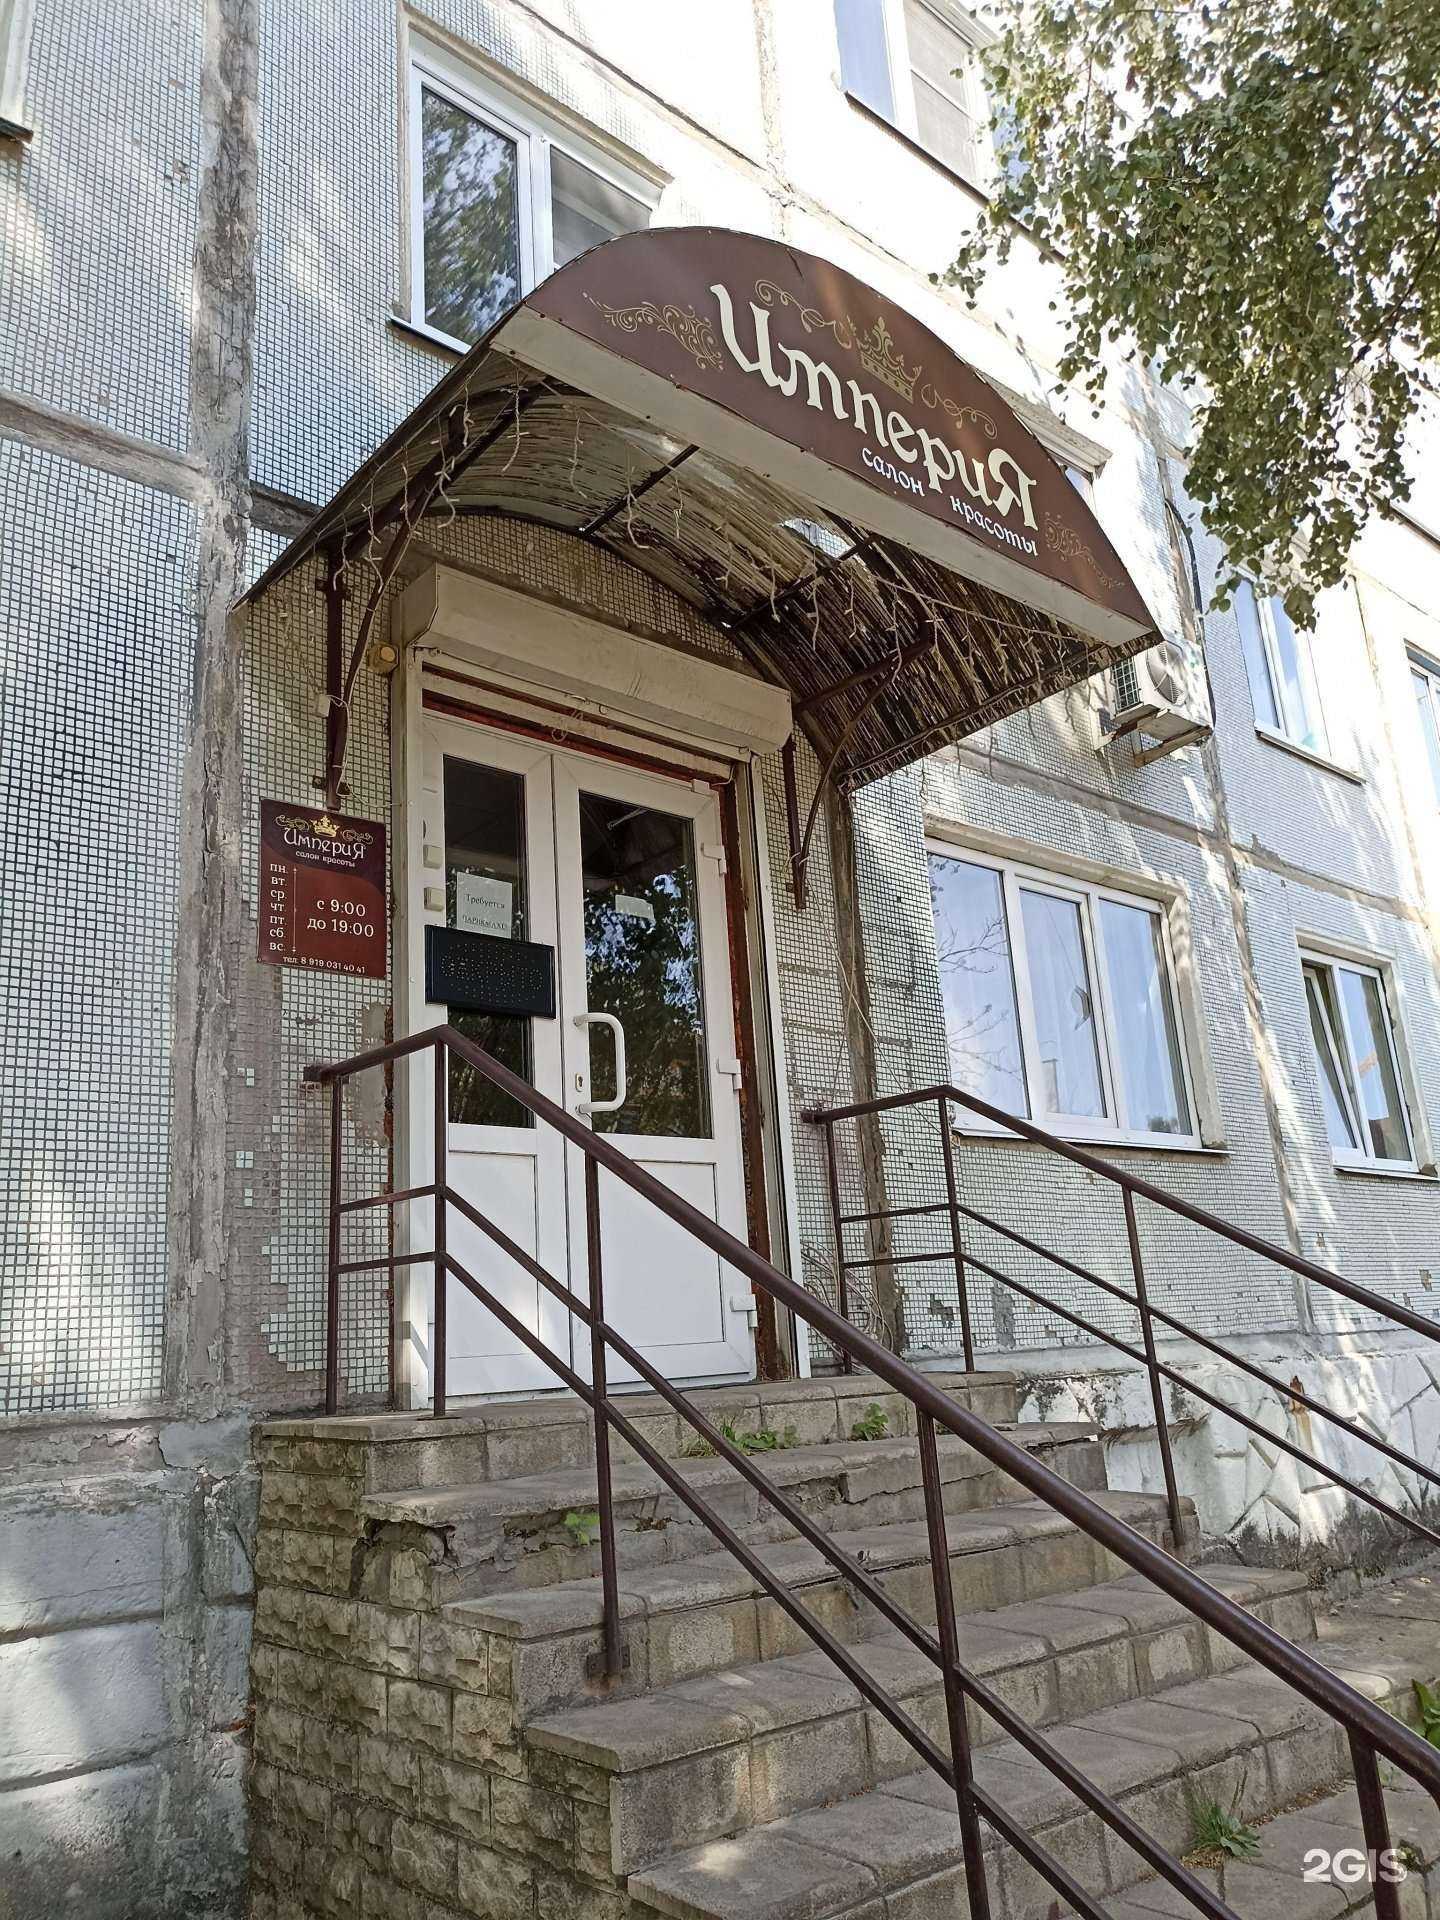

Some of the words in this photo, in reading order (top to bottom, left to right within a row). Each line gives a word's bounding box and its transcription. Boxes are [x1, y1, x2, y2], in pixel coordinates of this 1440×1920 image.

[861, 447, 925, 497] салон
[951, 495, 1039, 556] красоты
[296, 850, 320, 861] салон
[322, 855, 356, 868] красоты
[330, 899, 366, 917] 9:00
[464, 893, 505, 909] Требуется
[307, 918, 326, 930] до
[331, 918, 374, 938] 19:00
